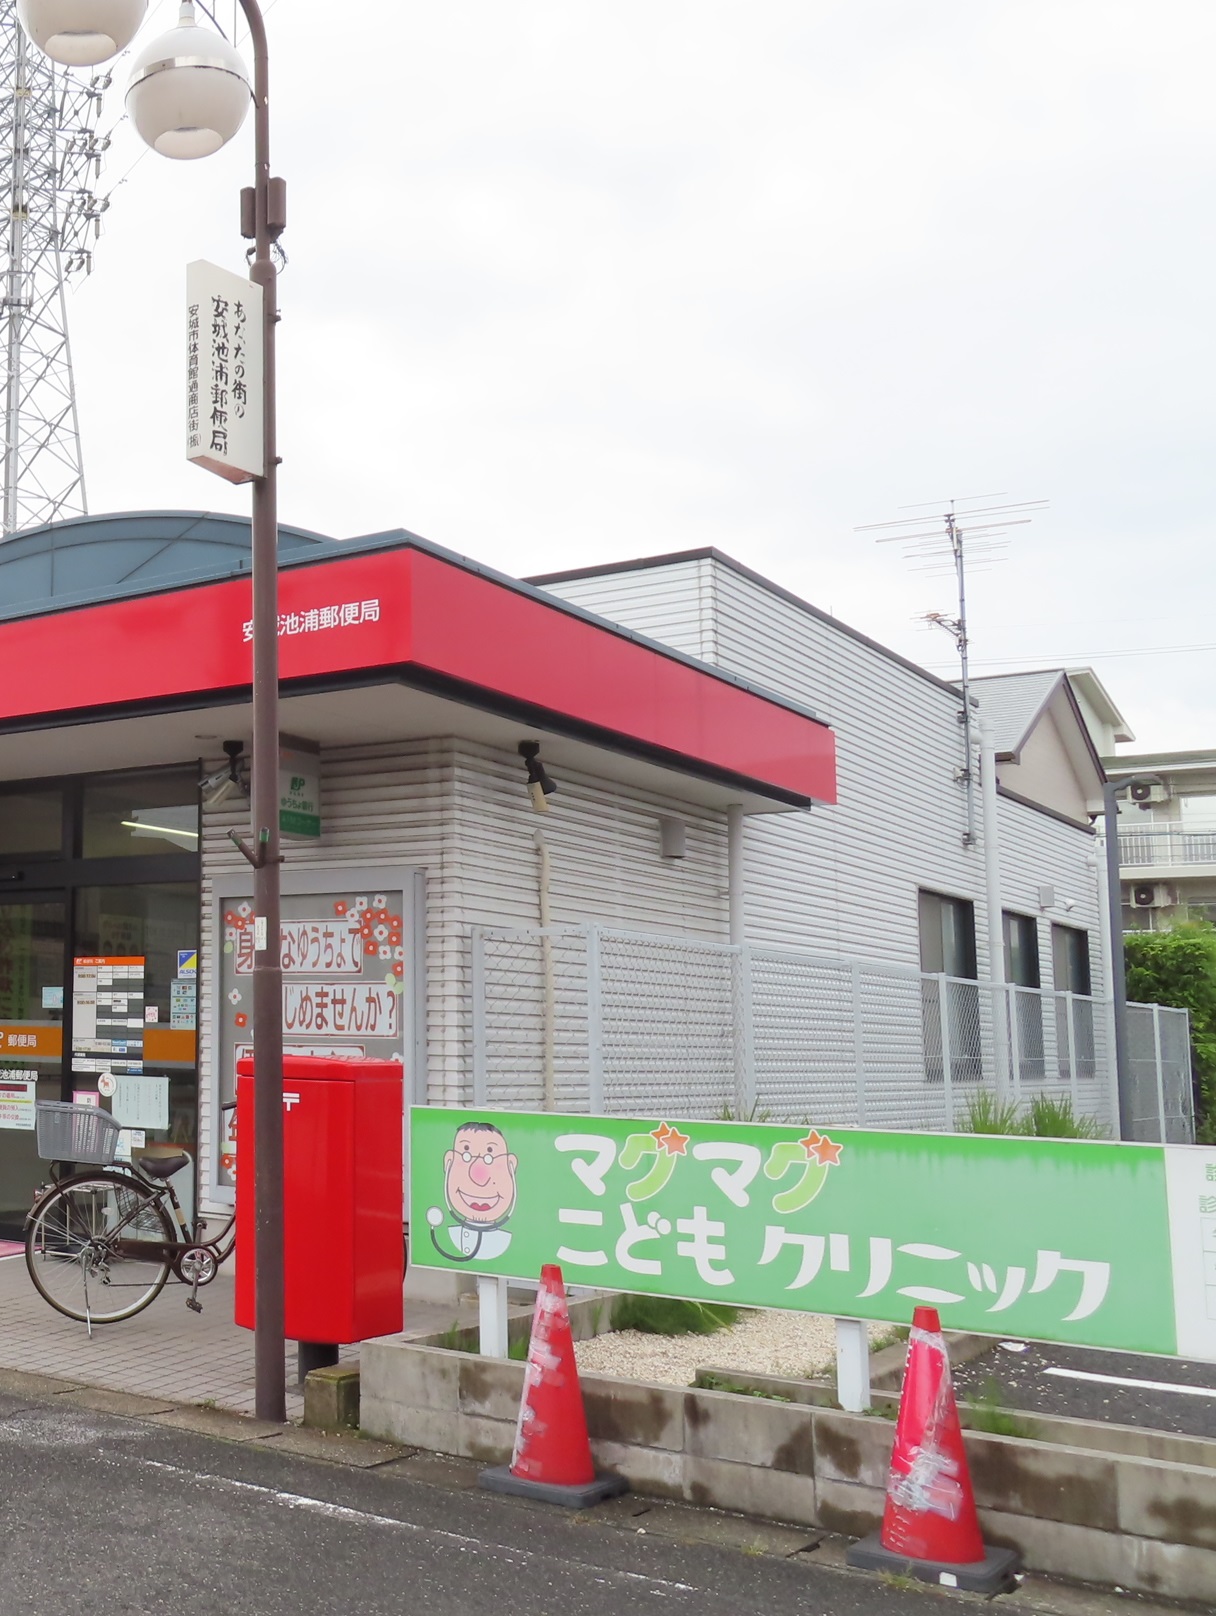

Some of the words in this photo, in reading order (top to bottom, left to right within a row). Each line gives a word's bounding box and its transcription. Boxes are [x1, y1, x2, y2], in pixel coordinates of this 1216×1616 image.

[210, 294, 230, 456] 安城池浦郵便局
[242, 599, 380, 643] 安池浦郵便局
[237, 924, 362, 969] 身なゆうちょで
[283, 985, 396, 1032] じめませんか？
[7, 1034, 37, 1048] 郵便局
